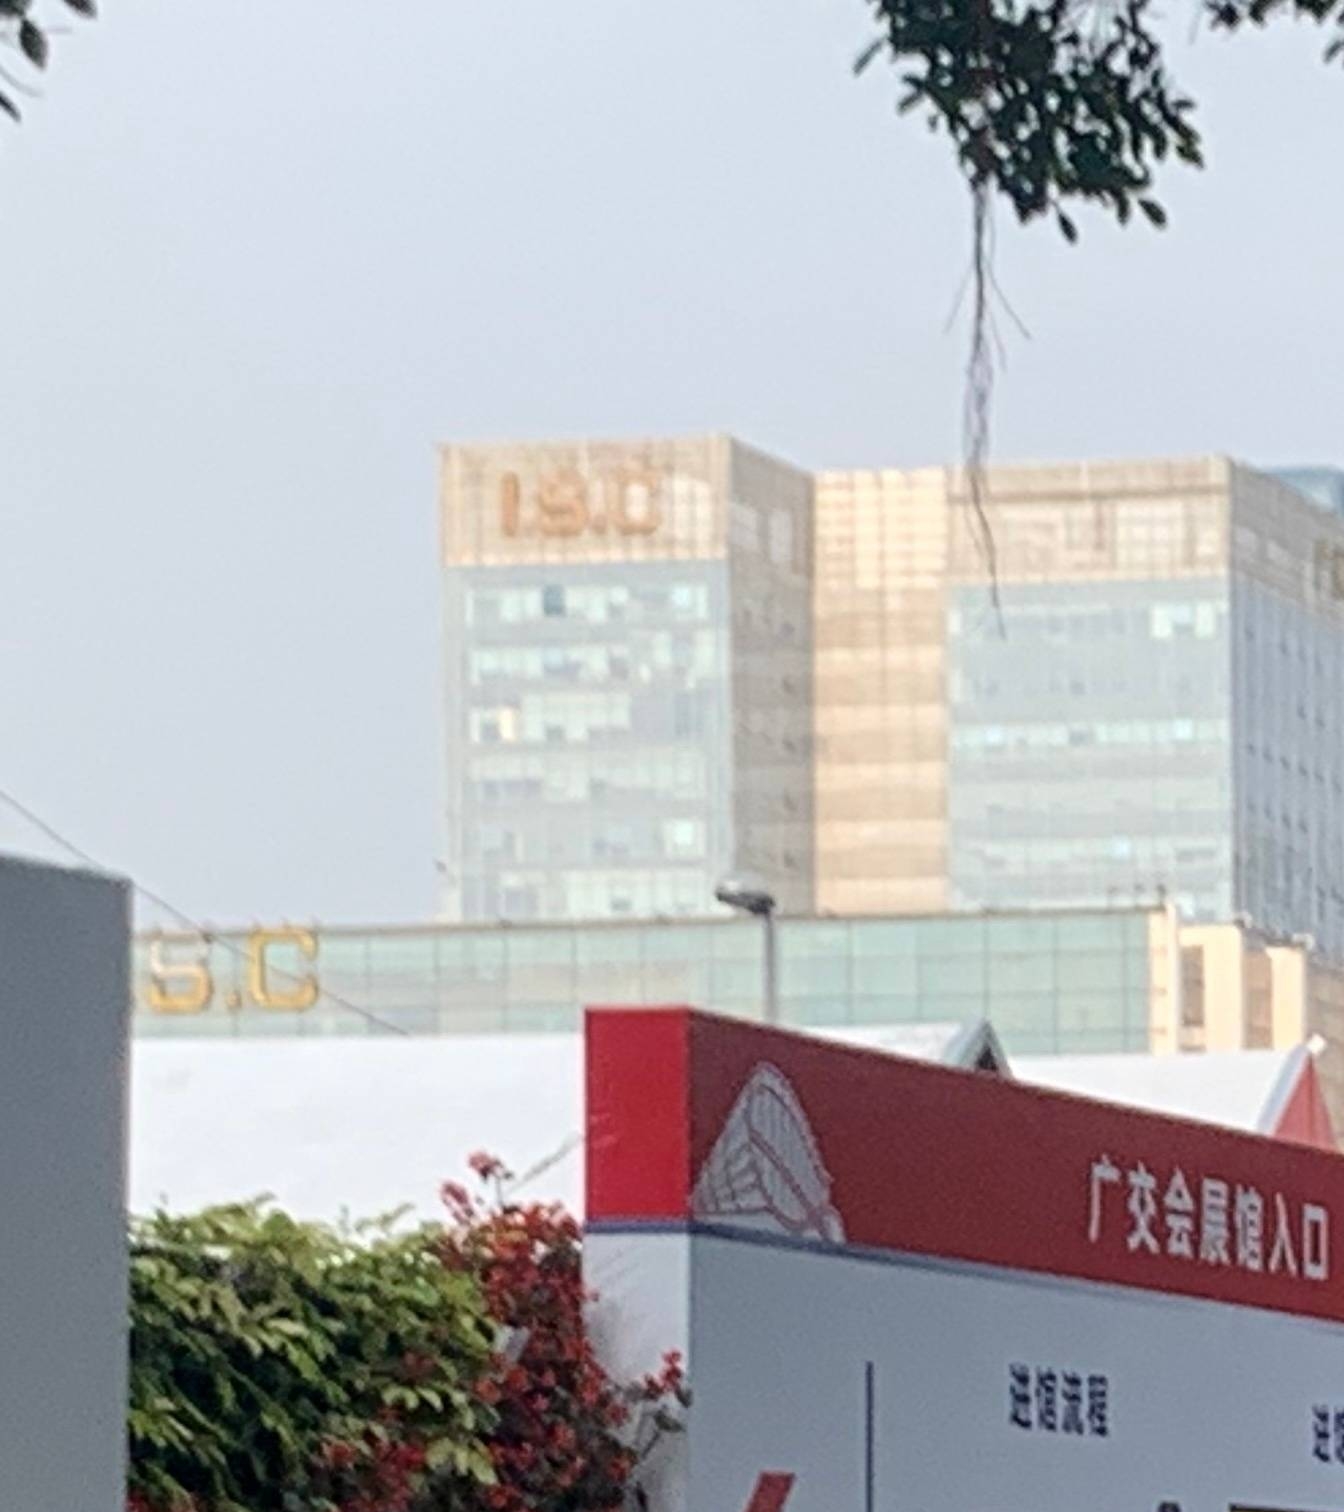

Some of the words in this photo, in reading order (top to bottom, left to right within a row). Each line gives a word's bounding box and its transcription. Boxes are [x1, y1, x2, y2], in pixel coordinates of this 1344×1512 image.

[1088, 1153, 1331, 1282] 广交会展馆入口
